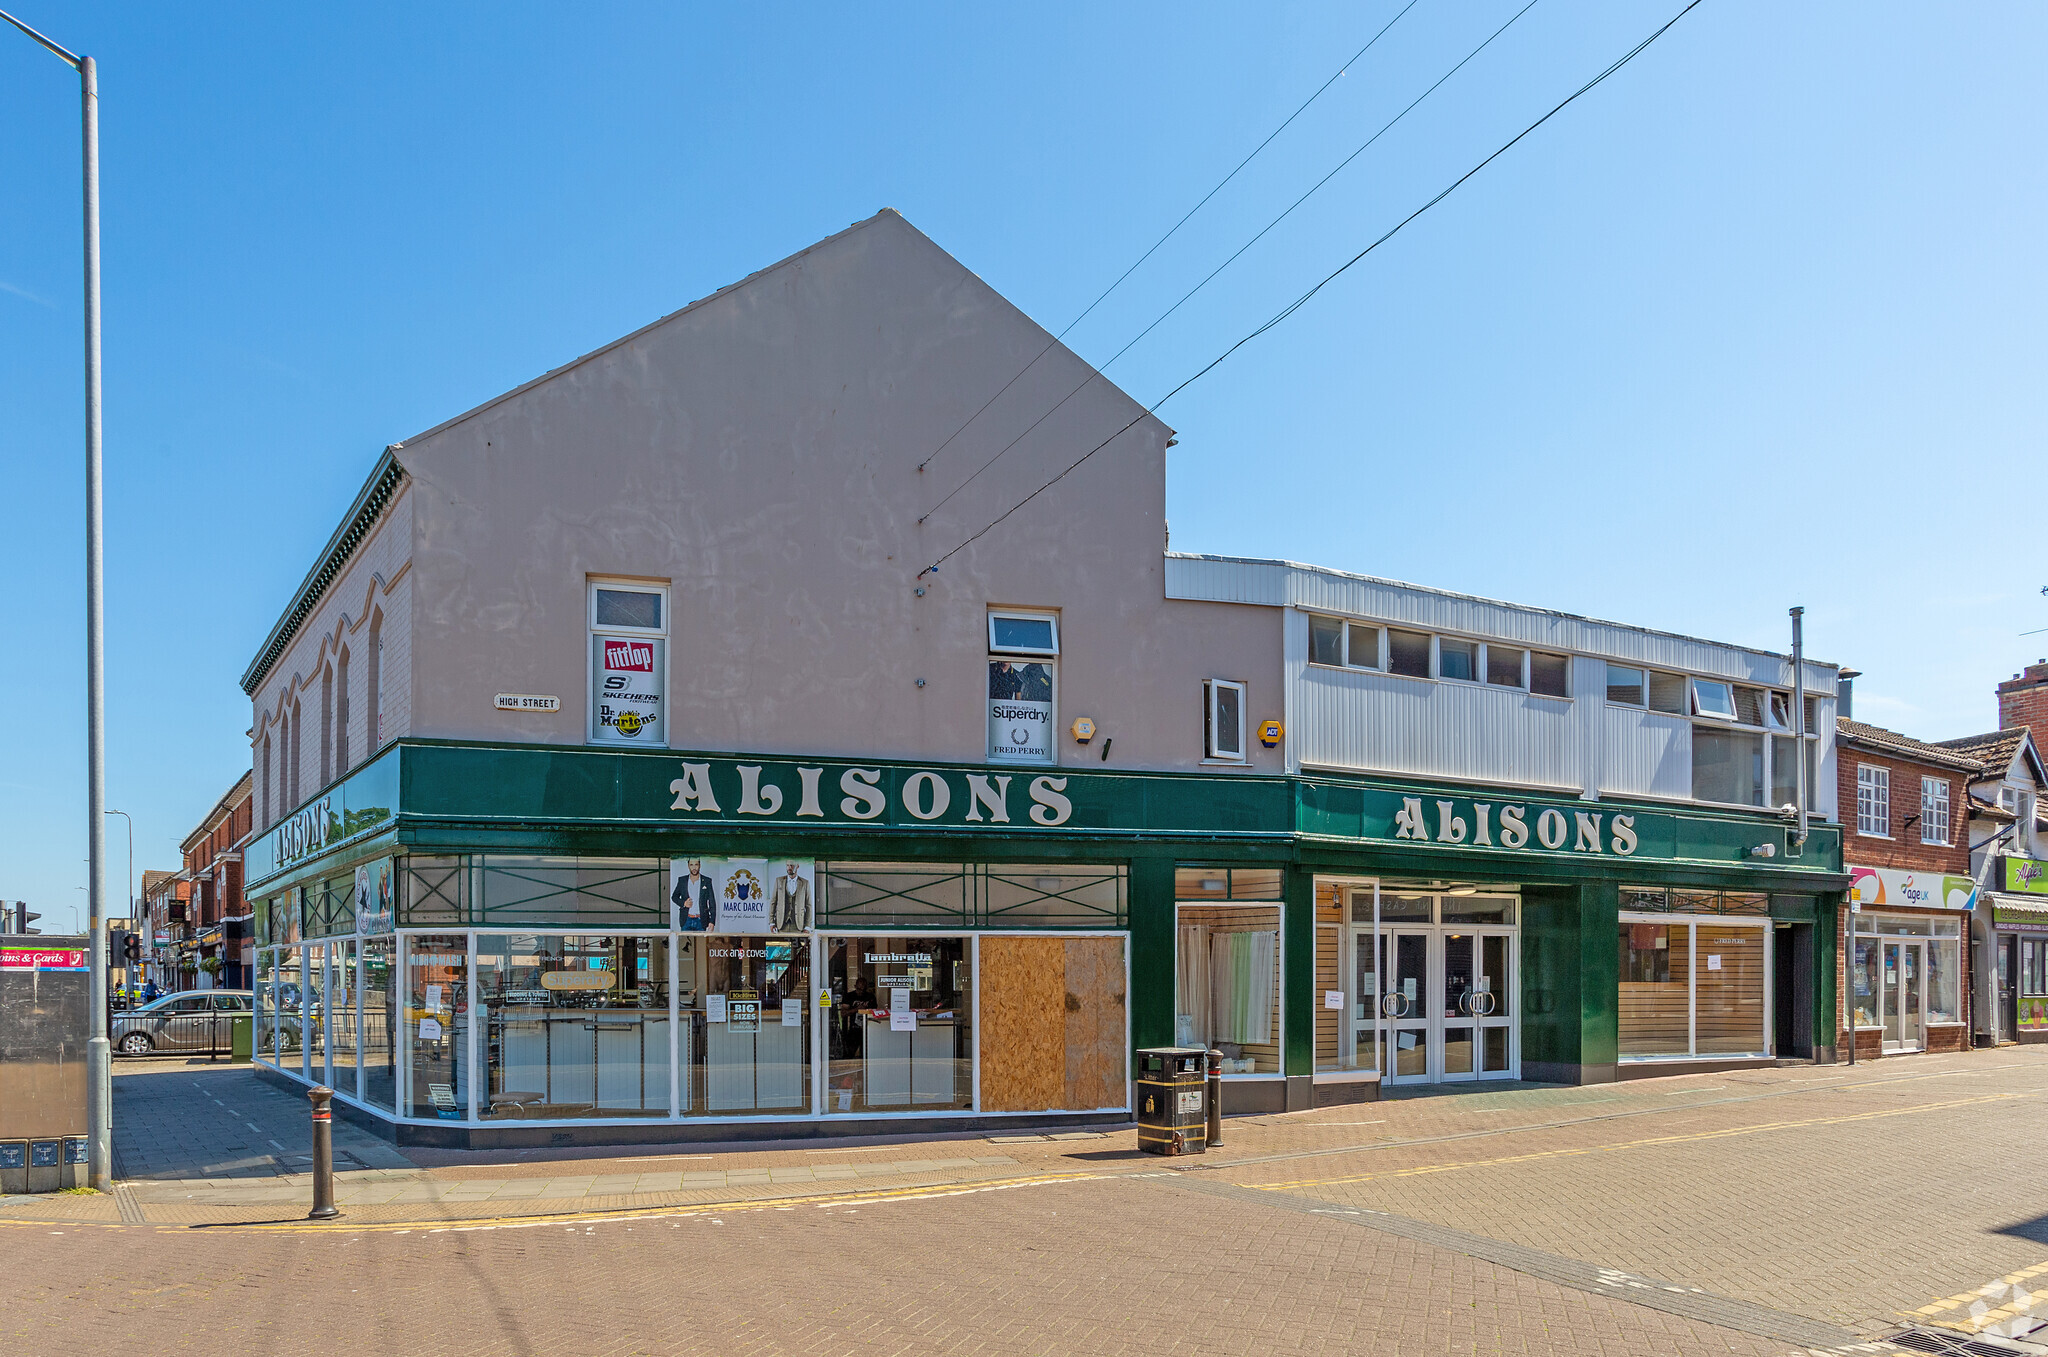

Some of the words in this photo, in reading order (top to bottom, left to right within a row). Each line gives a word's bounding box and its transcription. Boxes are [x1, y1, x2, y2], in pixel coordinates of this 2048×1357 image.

[606, 641, 652, 670] fitflop
[602, 692, 660, 700] SKECHERS
[499, 697, 519, 706] HIGH
[522, 698, 555, 708] STREET
[600, 705, 615, 716] Dr.
[992, 706, 1049, 724] Superdry.
[600, 713, 657, 728] Martens
[1266, 728, 1278, 736] ADT
[994, 746, 1017, 754] FRED
[1018, 747, 1046, 755] PERRY
[669, 761, 1073, 826] ALISONS
[275, 796, 331, 865] ALISONS
[1395, 796, 1638, 856] ALISONS
[2015, 861, 2042, 889] Alfie's
[1907, 889, 1921, 904] age
[1921, 890, 1929, 900] UK
[723, 902, 741, 912] MARC
[743, 902, 764, 912] DARCY
[21, 953, 31, 962] &
[33, 952, 64, 962] Cards
[709, 949, 728, 957] DUCK
[438, 954, 462, 966] MASH
[734, 1004, 755, 1013] BIG
